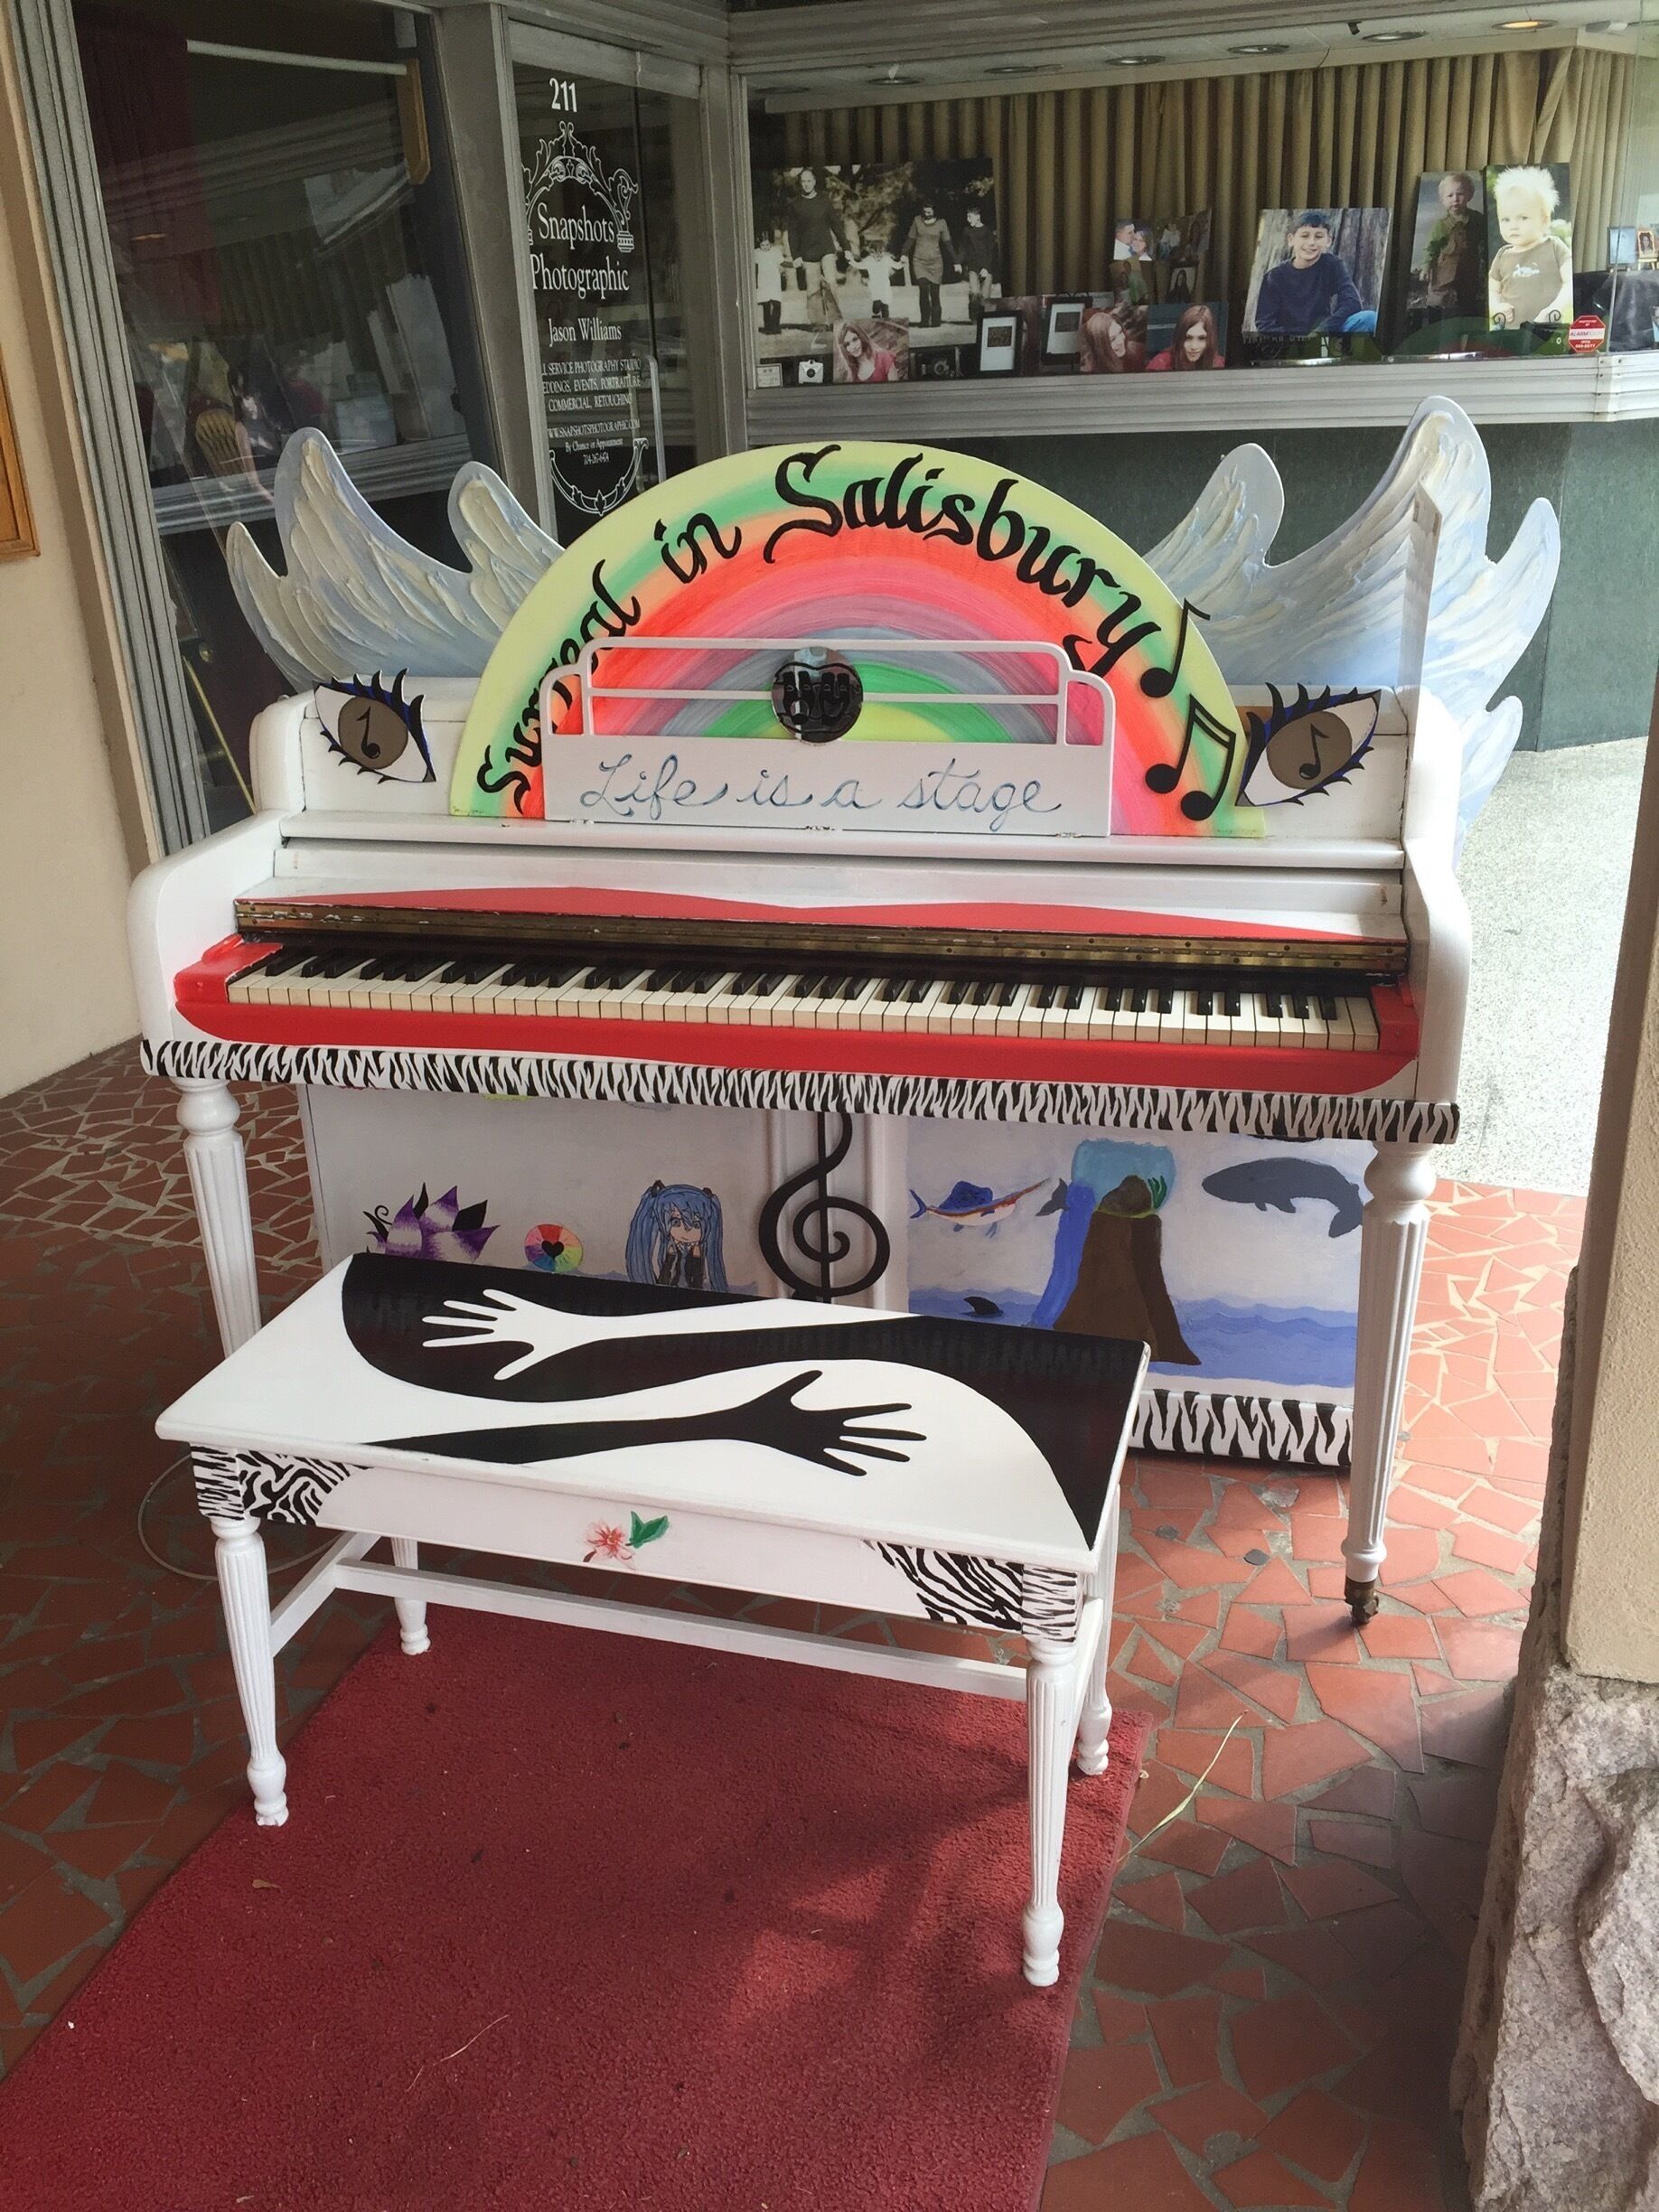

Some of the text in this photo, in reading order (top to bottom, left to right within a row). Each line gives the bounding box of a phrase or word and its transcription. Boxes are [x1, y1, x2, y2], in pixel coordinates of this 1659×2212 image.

[549, 78, 577, 113] 211
[538, 202, 614, 250] Snapshots
[530, 252, 630, 300] Photographic
[548, 317, 622, 348] Jason Williams
[542, 380, 571, 394] EDDINGS,
[548, 362, 574, 376] SERVICE
[574, 360, 619, 374] PHOTOGRAPHY
[652, 511, 743, 585] in
[763, 443, 1163, 683] Salisbury
[579, 754, 1063, 832] Life is a stage
